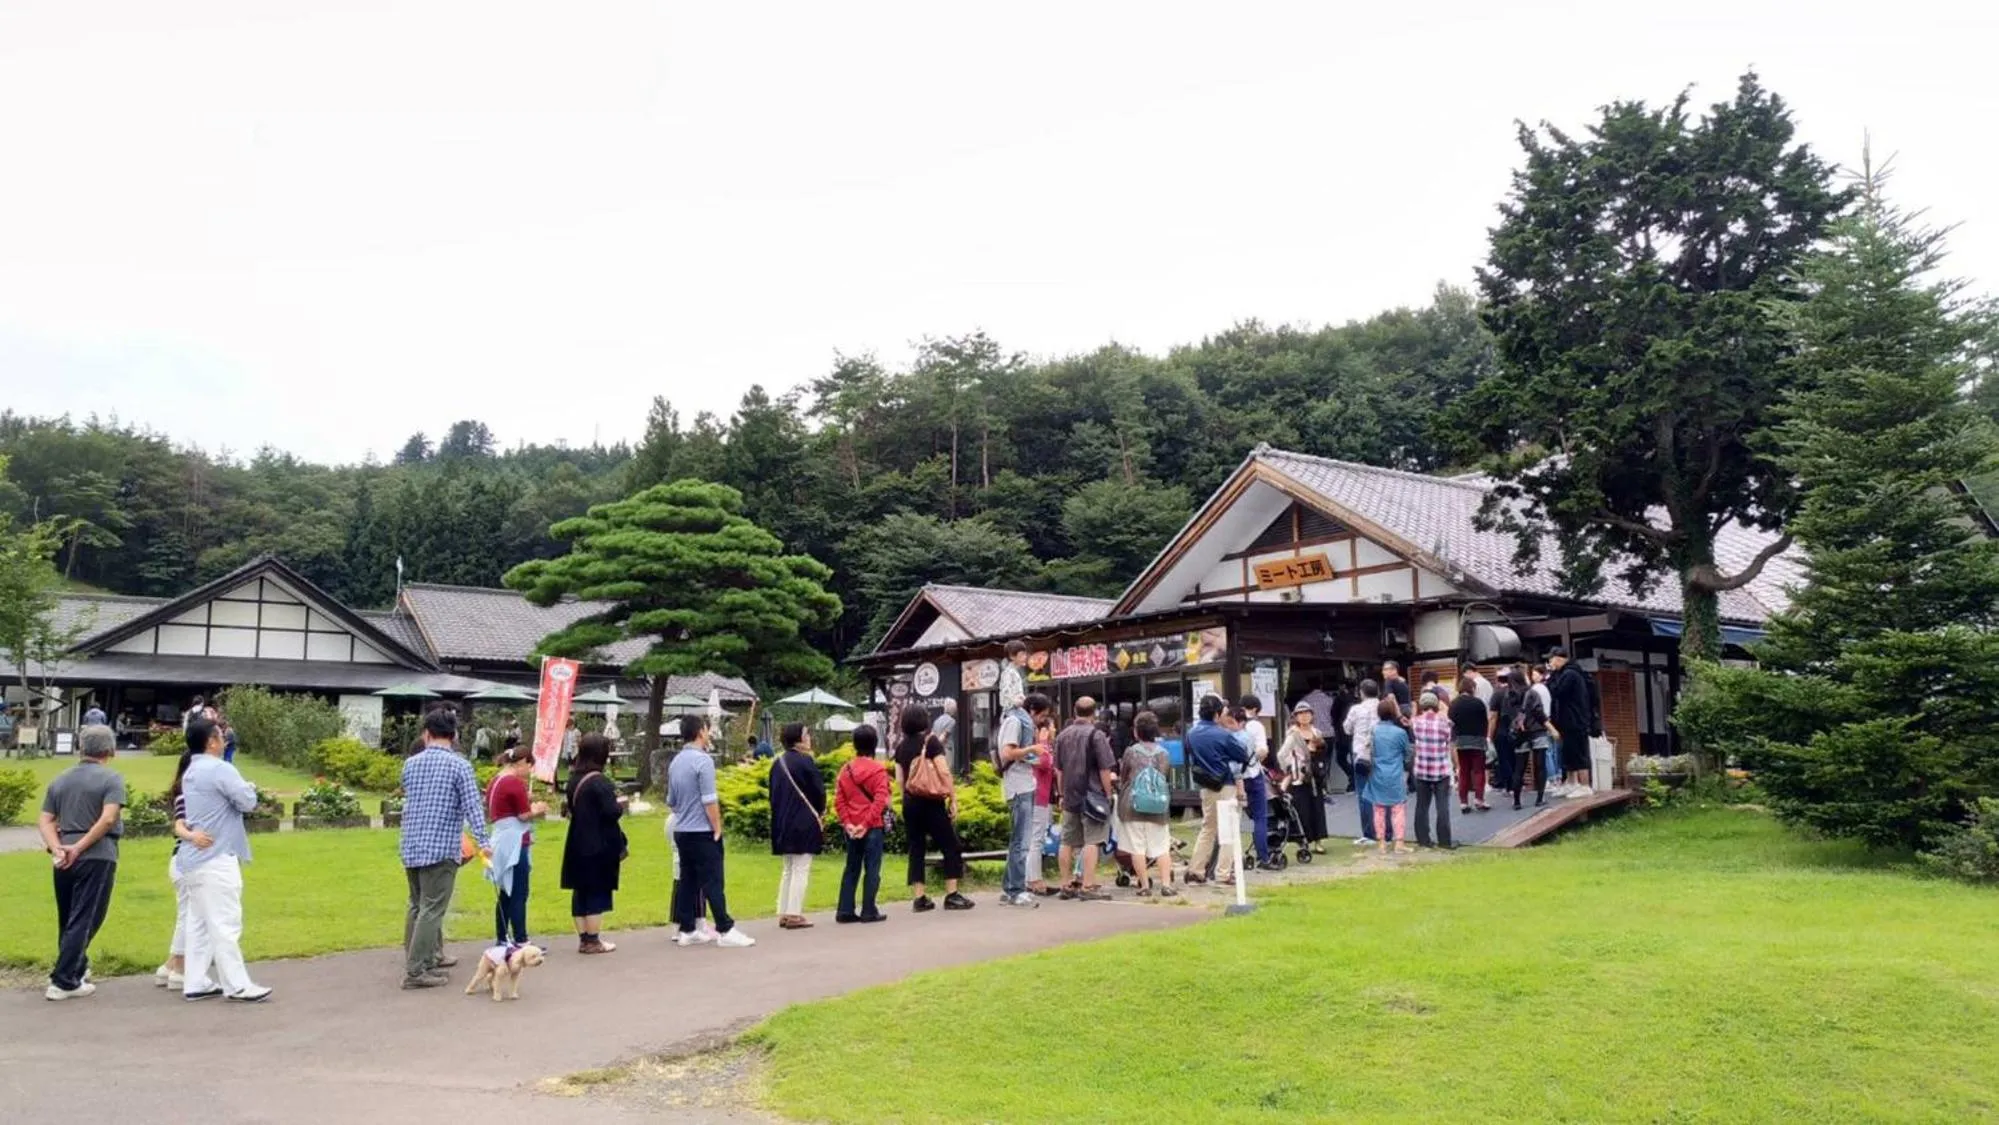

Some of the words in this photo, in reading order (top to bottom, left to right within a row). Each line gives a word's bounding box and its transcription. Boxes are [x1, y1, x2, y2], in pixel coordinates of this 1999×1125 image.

[1260, 560, 1325, 583] ミート工房
